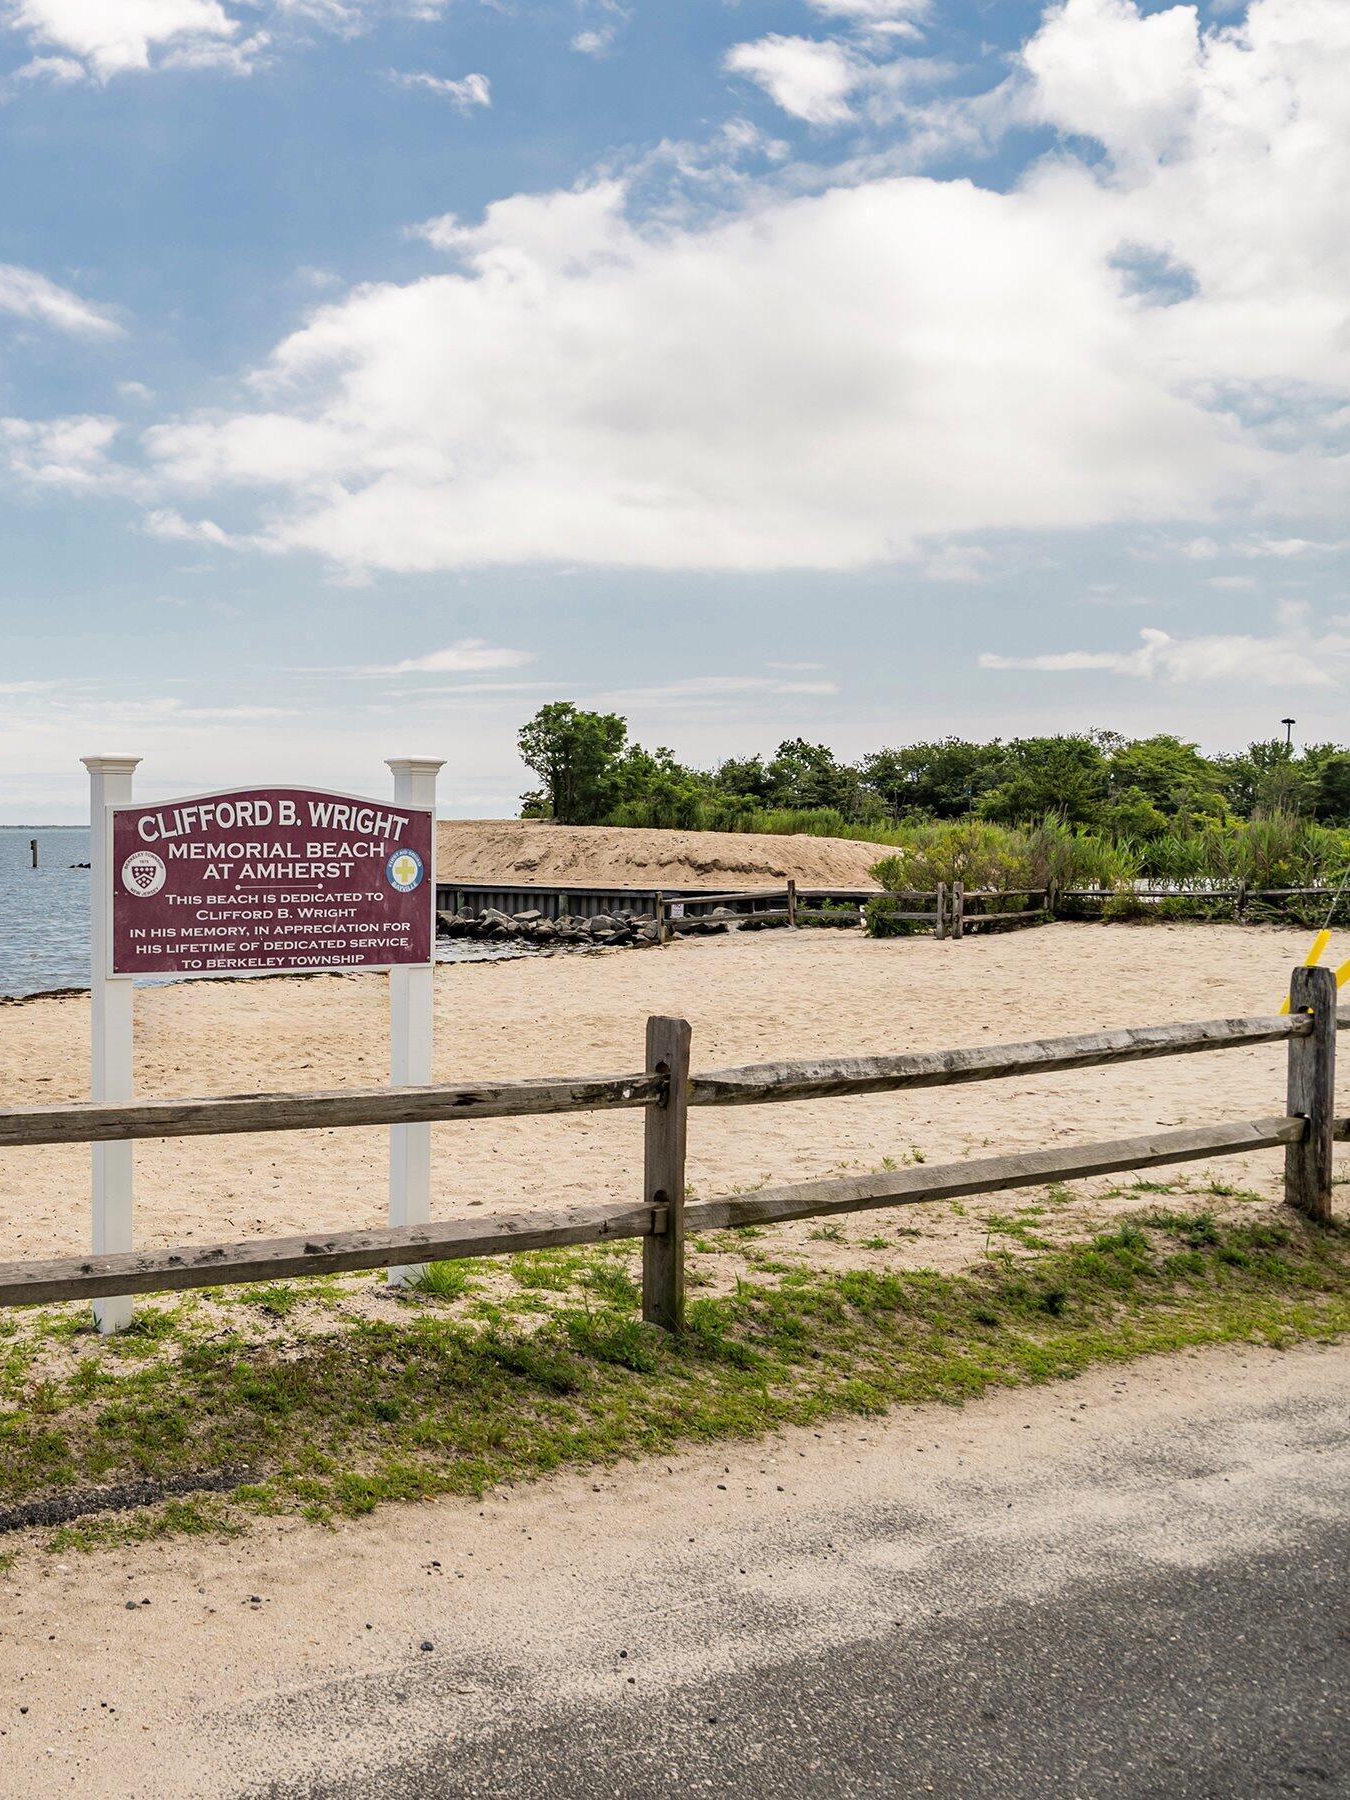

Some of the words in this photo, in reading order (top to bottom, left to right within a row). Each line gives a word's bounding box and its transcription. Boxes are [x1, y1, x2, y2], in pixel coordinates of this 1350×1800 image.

[137, 800, 273, 843] CLIFFORD
[278, 800, 301, 827] B.
[307, 801, 409, 841] WRIGHT
[168, 843, 300, 859] MEMORIAL
[306, 842, 385, 858] BEACH
[203, 863, 234, 880] AT
[239, 862, 355, 879] AMHERST
[206, 893, 258, 904] BEACH
[263, 893, 277, 903] IS
[280, 893, 362, 903] DEDICATED
[365, 892, 384, 901] TO
[277, 908, 293, 919] B.
[130, 928, 146, 938] IN
[151, 928, 177, 938] HIS
[181, 926, 250, 937] MEMORY,
[254, 926, 270, 936] IN
[273, 924, 380, 935] APPRECIATION
[383, 922, 411, 932] FOR
[136, 945, 162, 955] HIS
[166, 943, 236, 954] LIFETIME
[239, 942, 260, 952] OF
[263, 939, 347, 951] DEDICATED
[350, 938, 409, 948] SERVICE
[181, 960, 202, 969] TO
[206, 956, 285, 969] BERKELEY
[288, 954, 365, 966] TOWNSHIP
